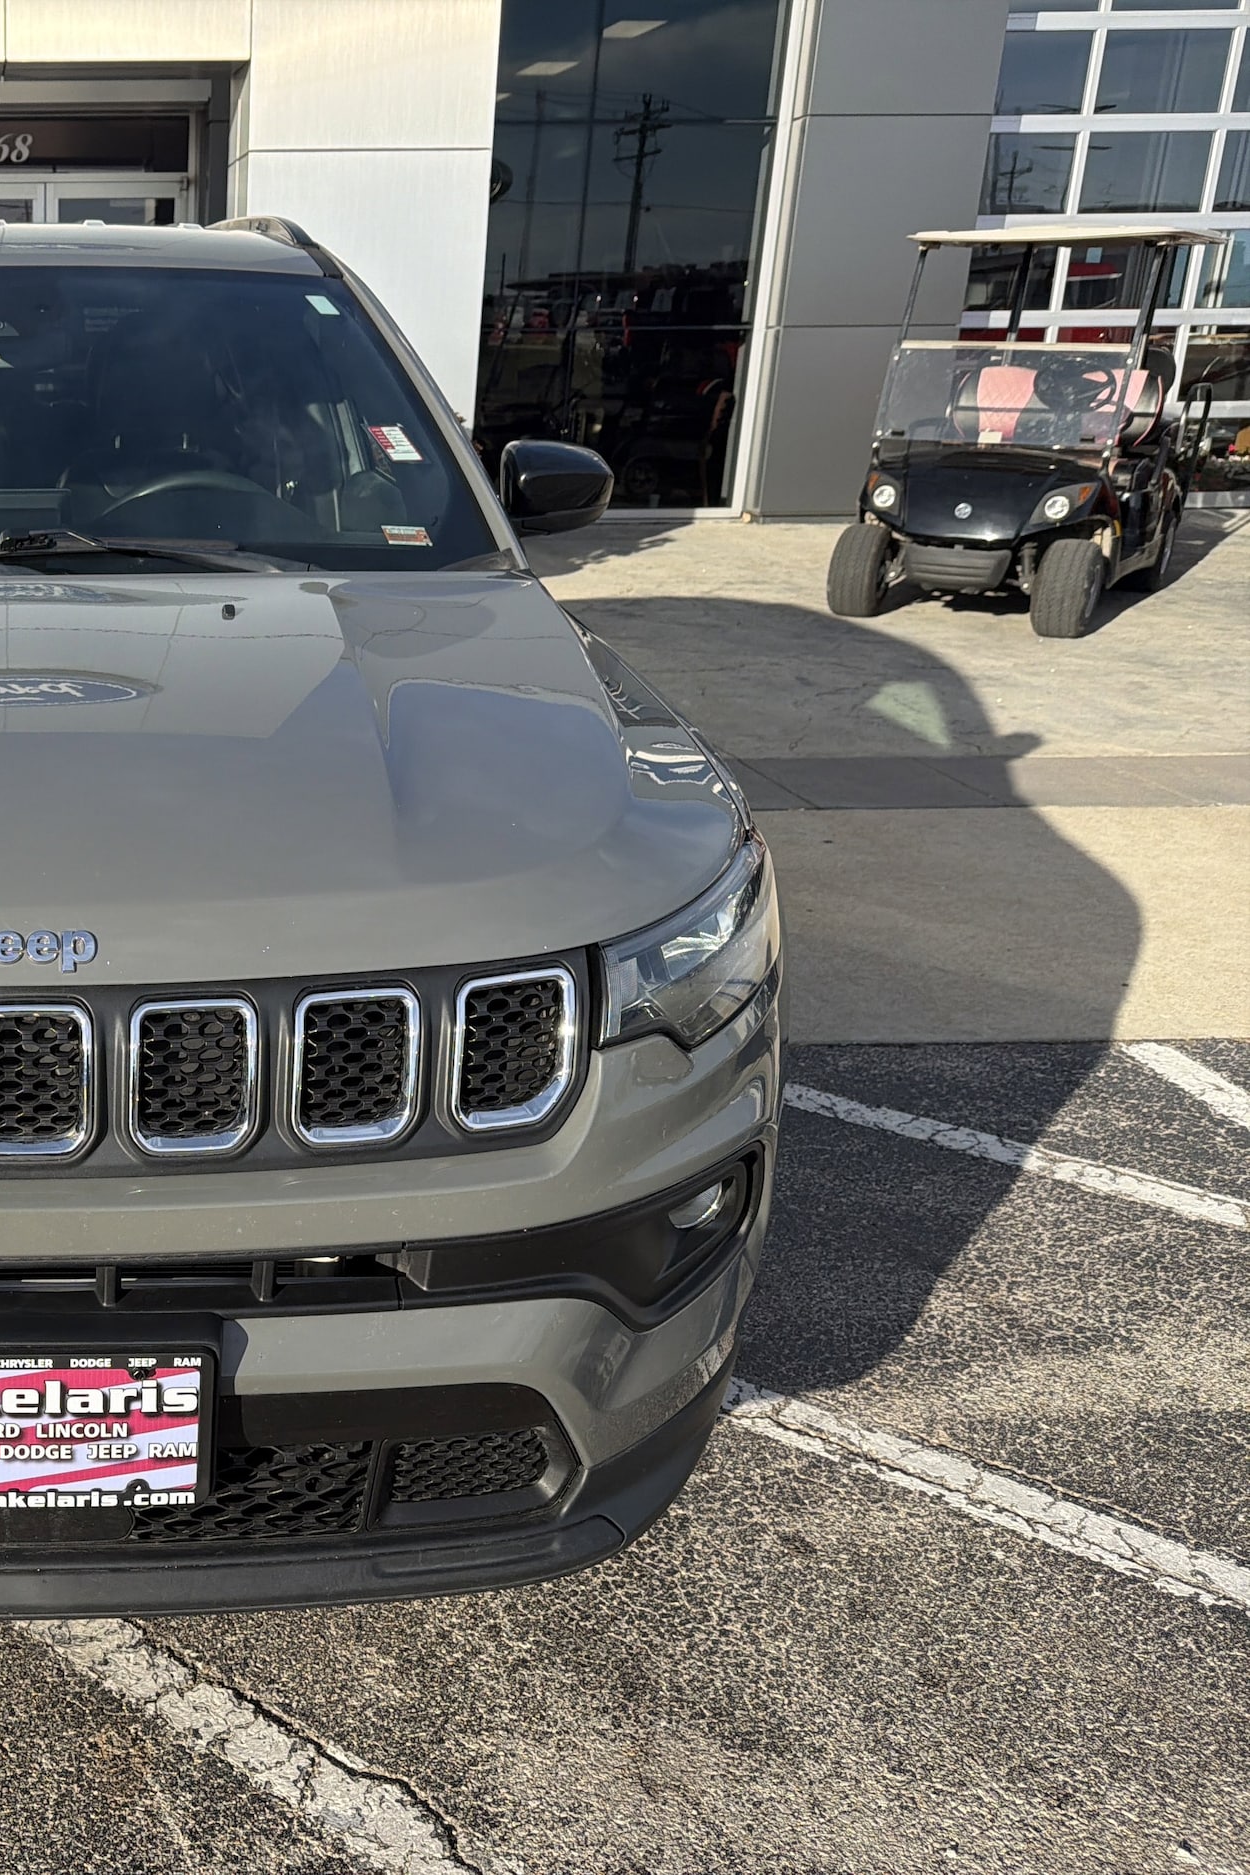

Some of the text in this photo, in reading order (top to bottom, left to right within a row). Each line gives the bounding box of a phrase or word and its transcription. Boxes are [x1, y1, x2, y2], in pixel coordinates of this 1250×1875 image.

[69, 1358, 112, 1369] DODGE
[127, 1357, 157, 1368] JEEP
[173, 1357, 202, 1367] RAM
[35, 1422, 129, 1439] LINCOLN
[86, 1443, 138, 1459] JEEP
[148, 1442, 198, 1459] RAM
